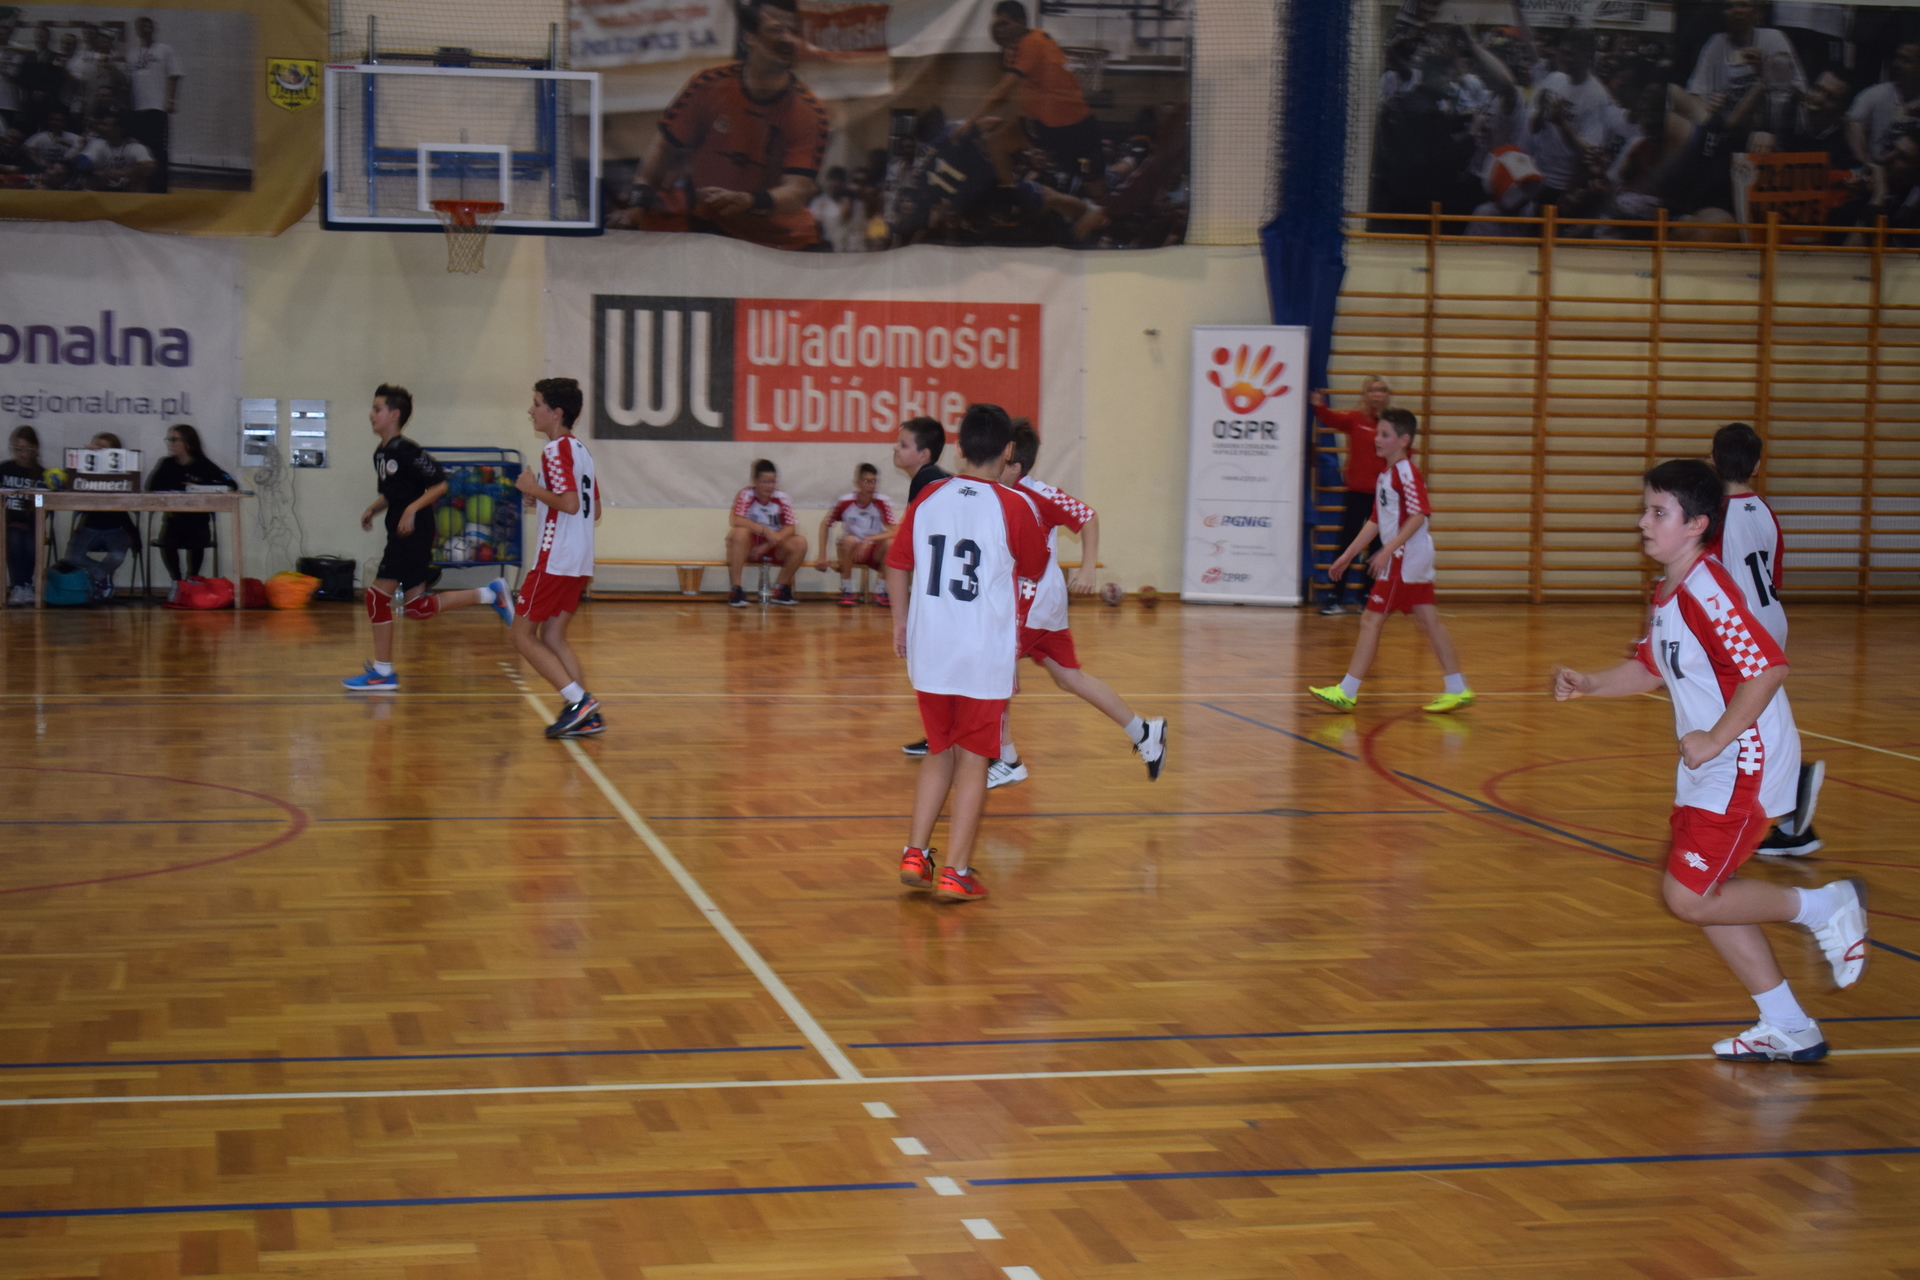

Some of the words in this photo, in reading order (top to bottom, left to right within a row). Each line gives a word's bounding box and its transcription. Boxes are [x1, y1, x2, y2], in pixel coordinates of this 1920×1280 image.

[746, 309, 1020, 370] Wiadomości
[746, 373, 967, 433] Lubińskie
[1212, 419, 1279, 440] OSPR
[1221, 515, 1272, 528] PGNiG
[926, 534, 981, 602] 13
